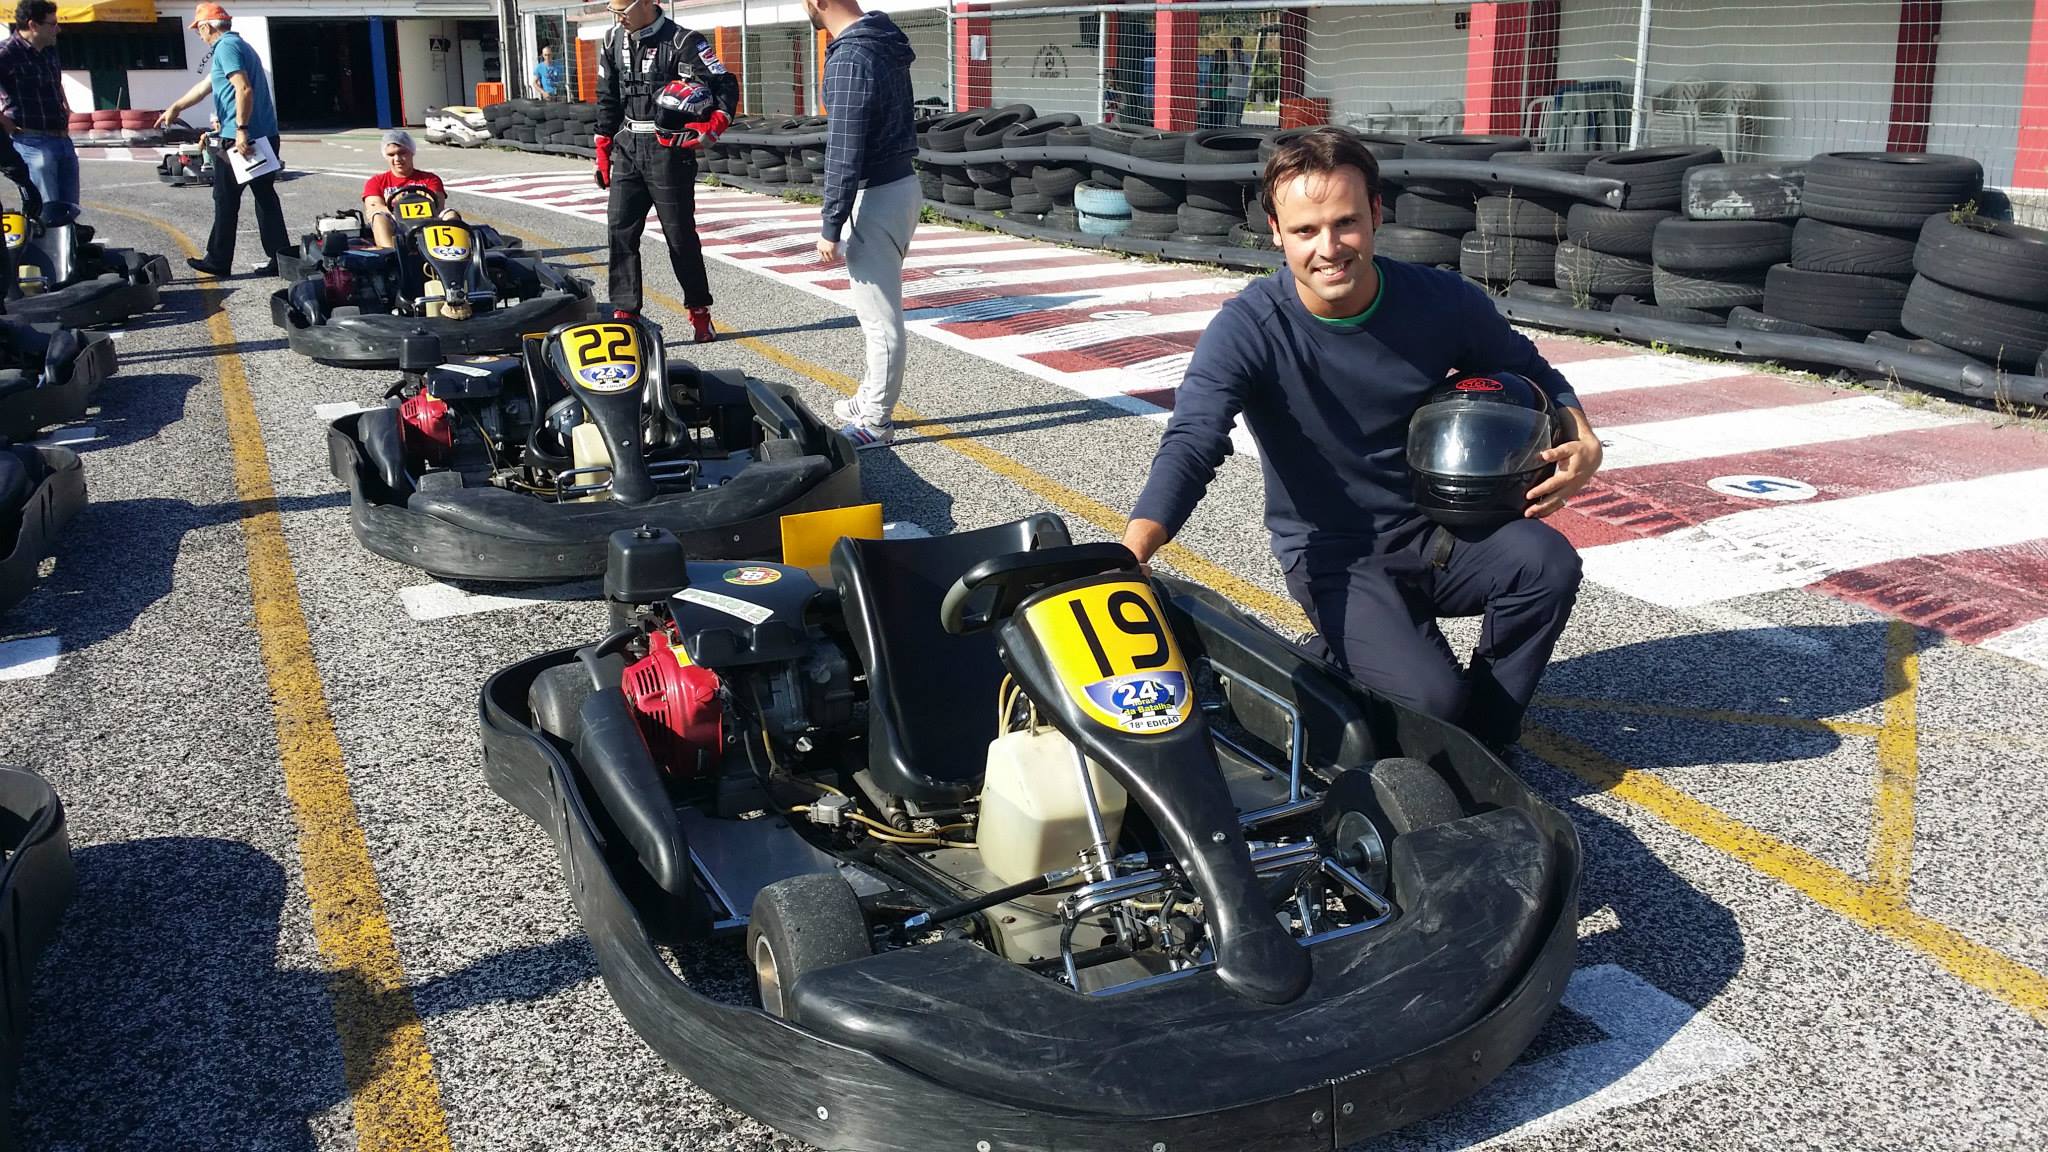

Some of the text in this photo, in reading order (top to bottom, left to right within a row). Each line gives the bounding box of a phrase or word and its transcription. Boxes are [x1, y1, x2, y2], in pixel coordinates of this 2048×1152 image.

[405, 204, 425, 216] 12
[433, 227, 454, 247] 15
[573, 326, 637, 367] 22
[1068, 590, 1170, 678] 19
[1118, 680, 1159, 706] 24
[1124, 703, 1172, 716] da Batalha
[1147, 716, 1179, 728] EDIÇÃO
